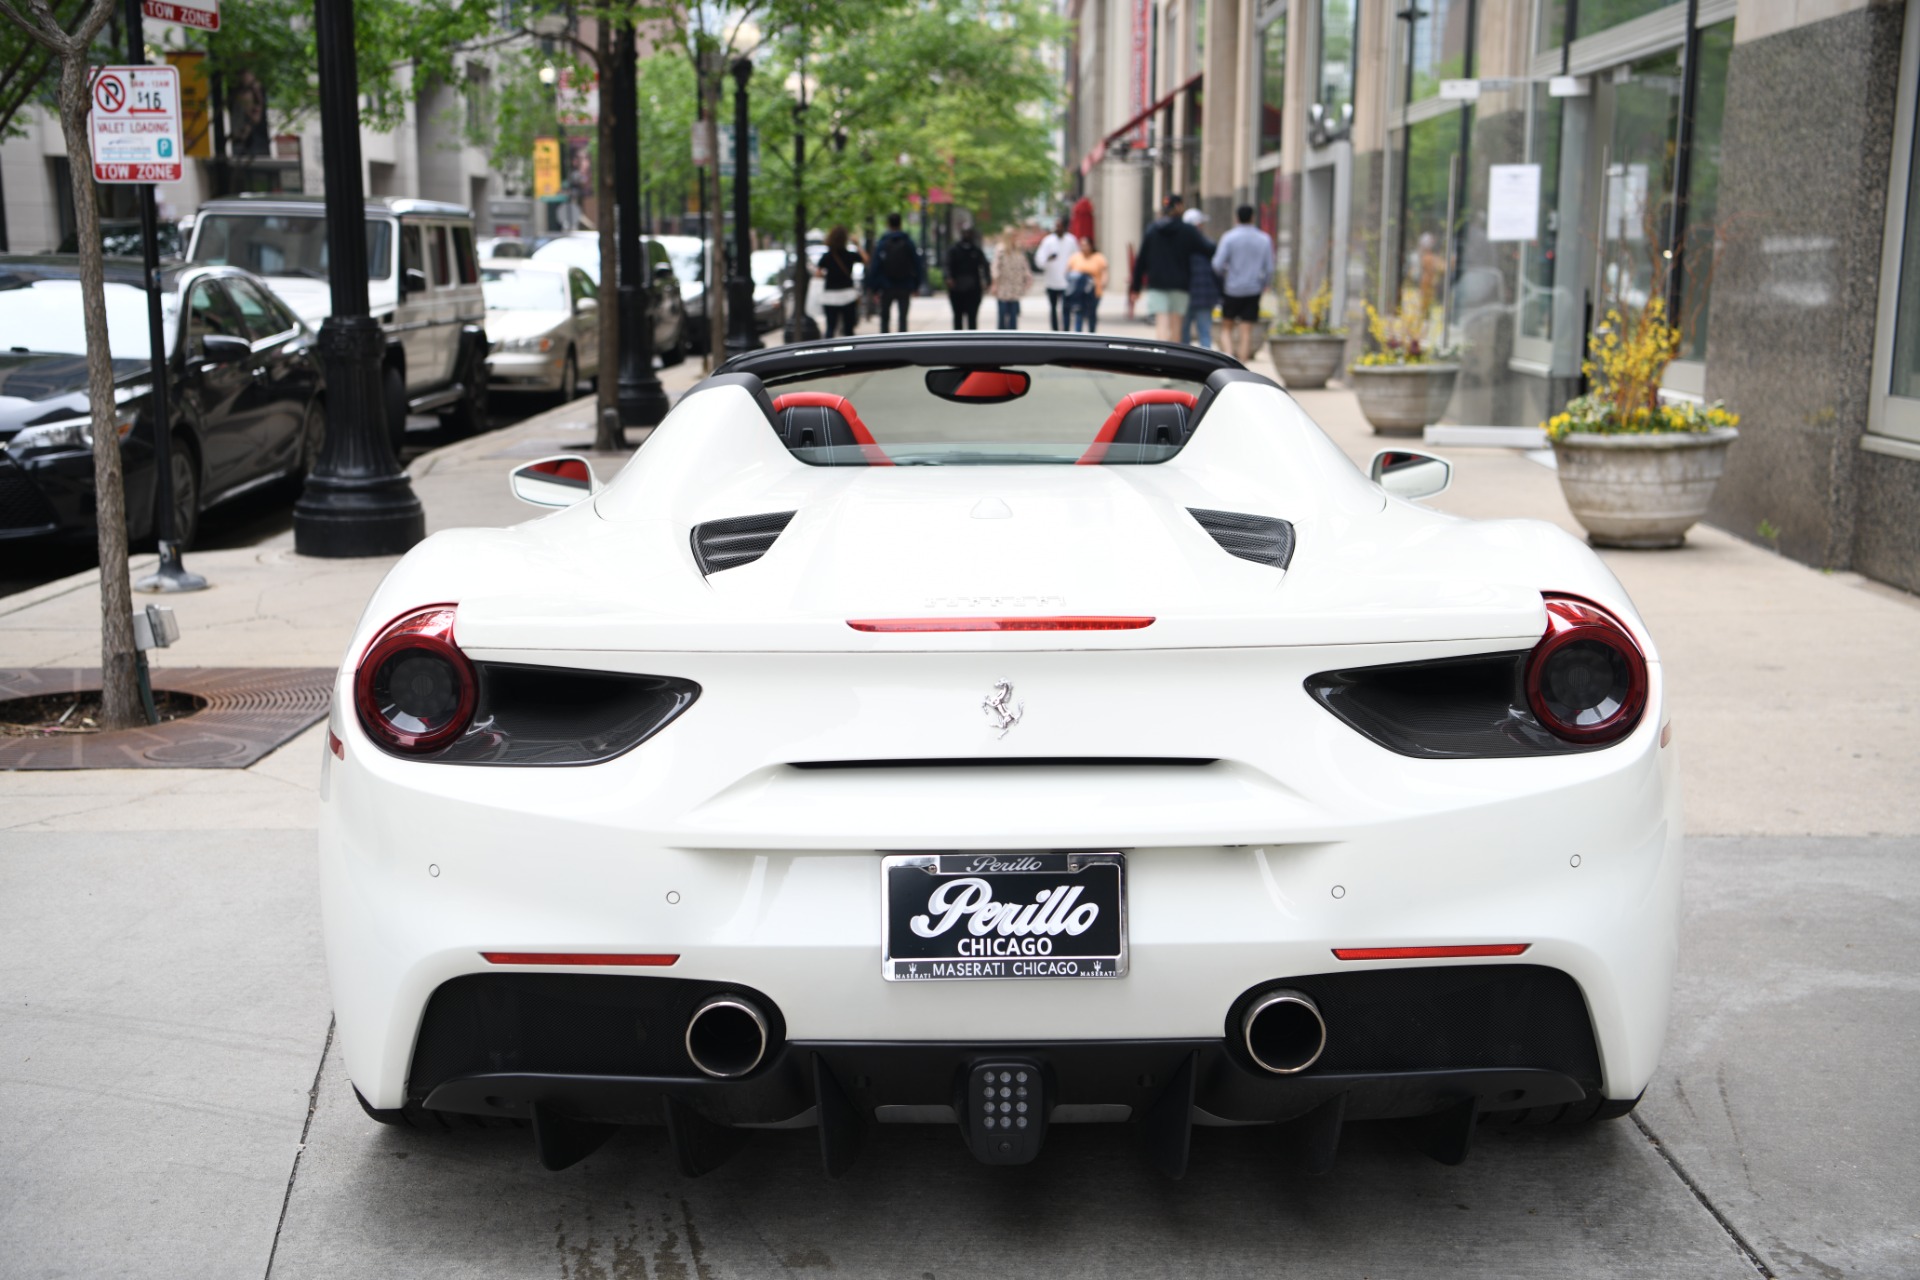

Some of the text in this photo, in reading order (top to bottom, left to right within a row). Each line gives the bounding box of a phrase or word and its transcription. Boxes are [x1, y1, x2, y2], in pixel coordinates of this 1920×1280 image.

[146, 1, 213, 27] TOW ZONE
[97, 122, 170, 135] VALET LOADING
[99, 165, 175, 180] TOW ZONE
[965, 856, 1043, 873] Perillo
[910, 877, 1100, 938] Perillo
[957, 938, 1053, 956] CHICAGO
[933, 961, 1079, 976] MASERATI CHICAGO
